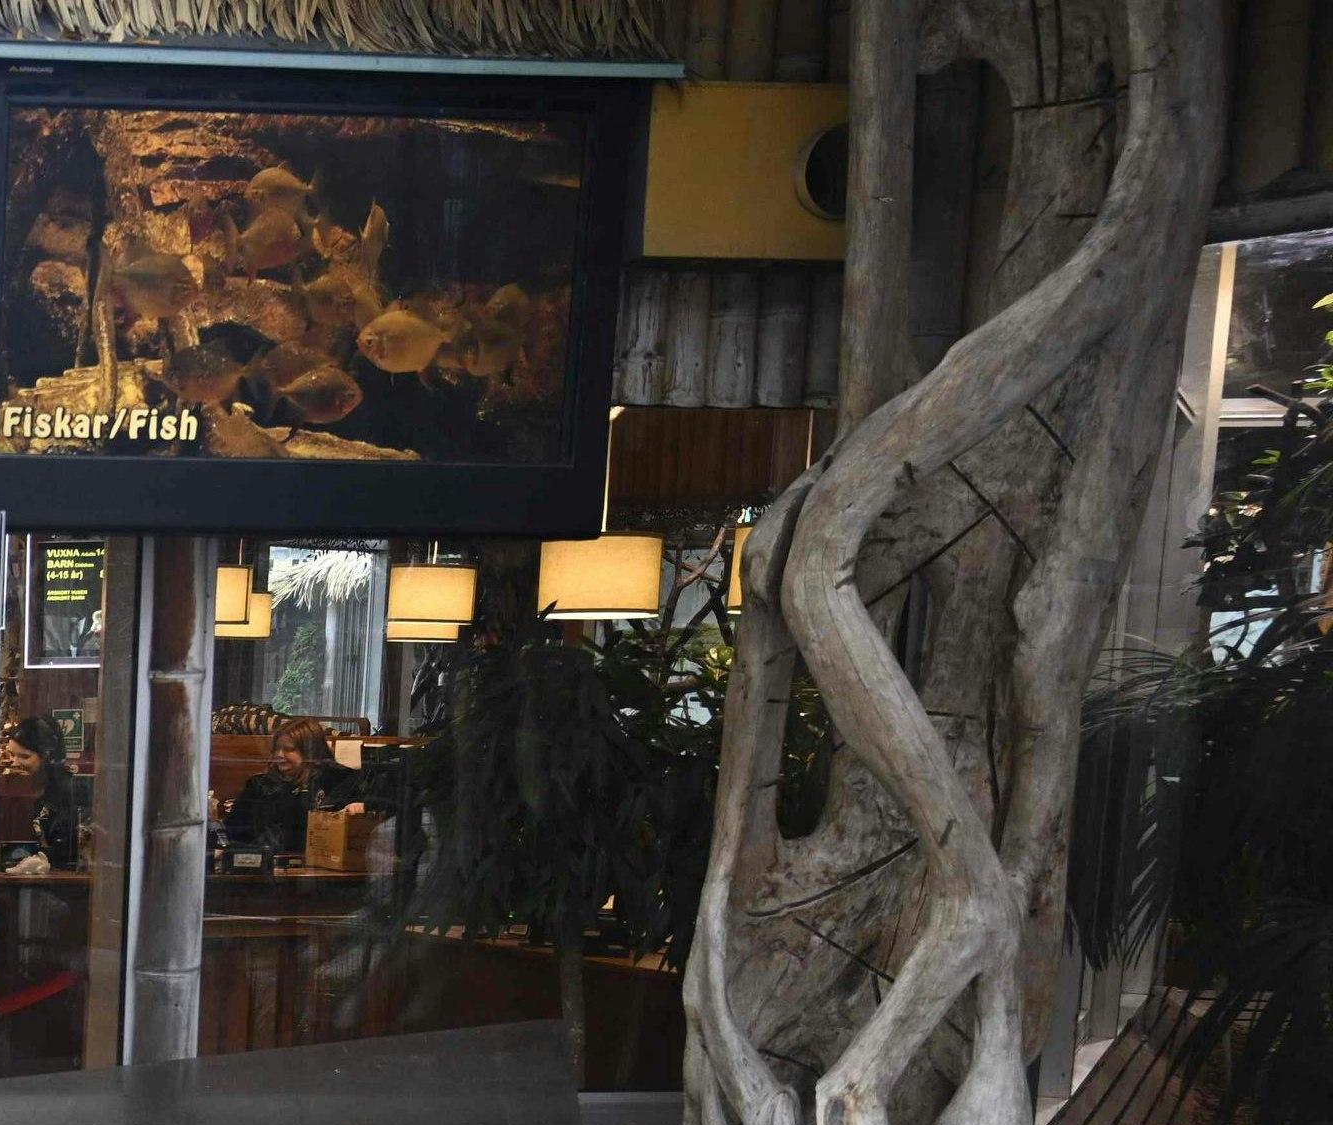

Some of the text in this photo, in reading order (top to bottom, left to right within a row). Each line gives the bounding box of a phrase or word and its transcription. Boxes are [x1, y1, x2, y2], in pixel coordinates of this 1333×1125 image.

[2, 406, 199, 441] Fiskar/Fish
[46, 548, 80, 557] VUXNA
[47, 560, 74, 568] BARN
